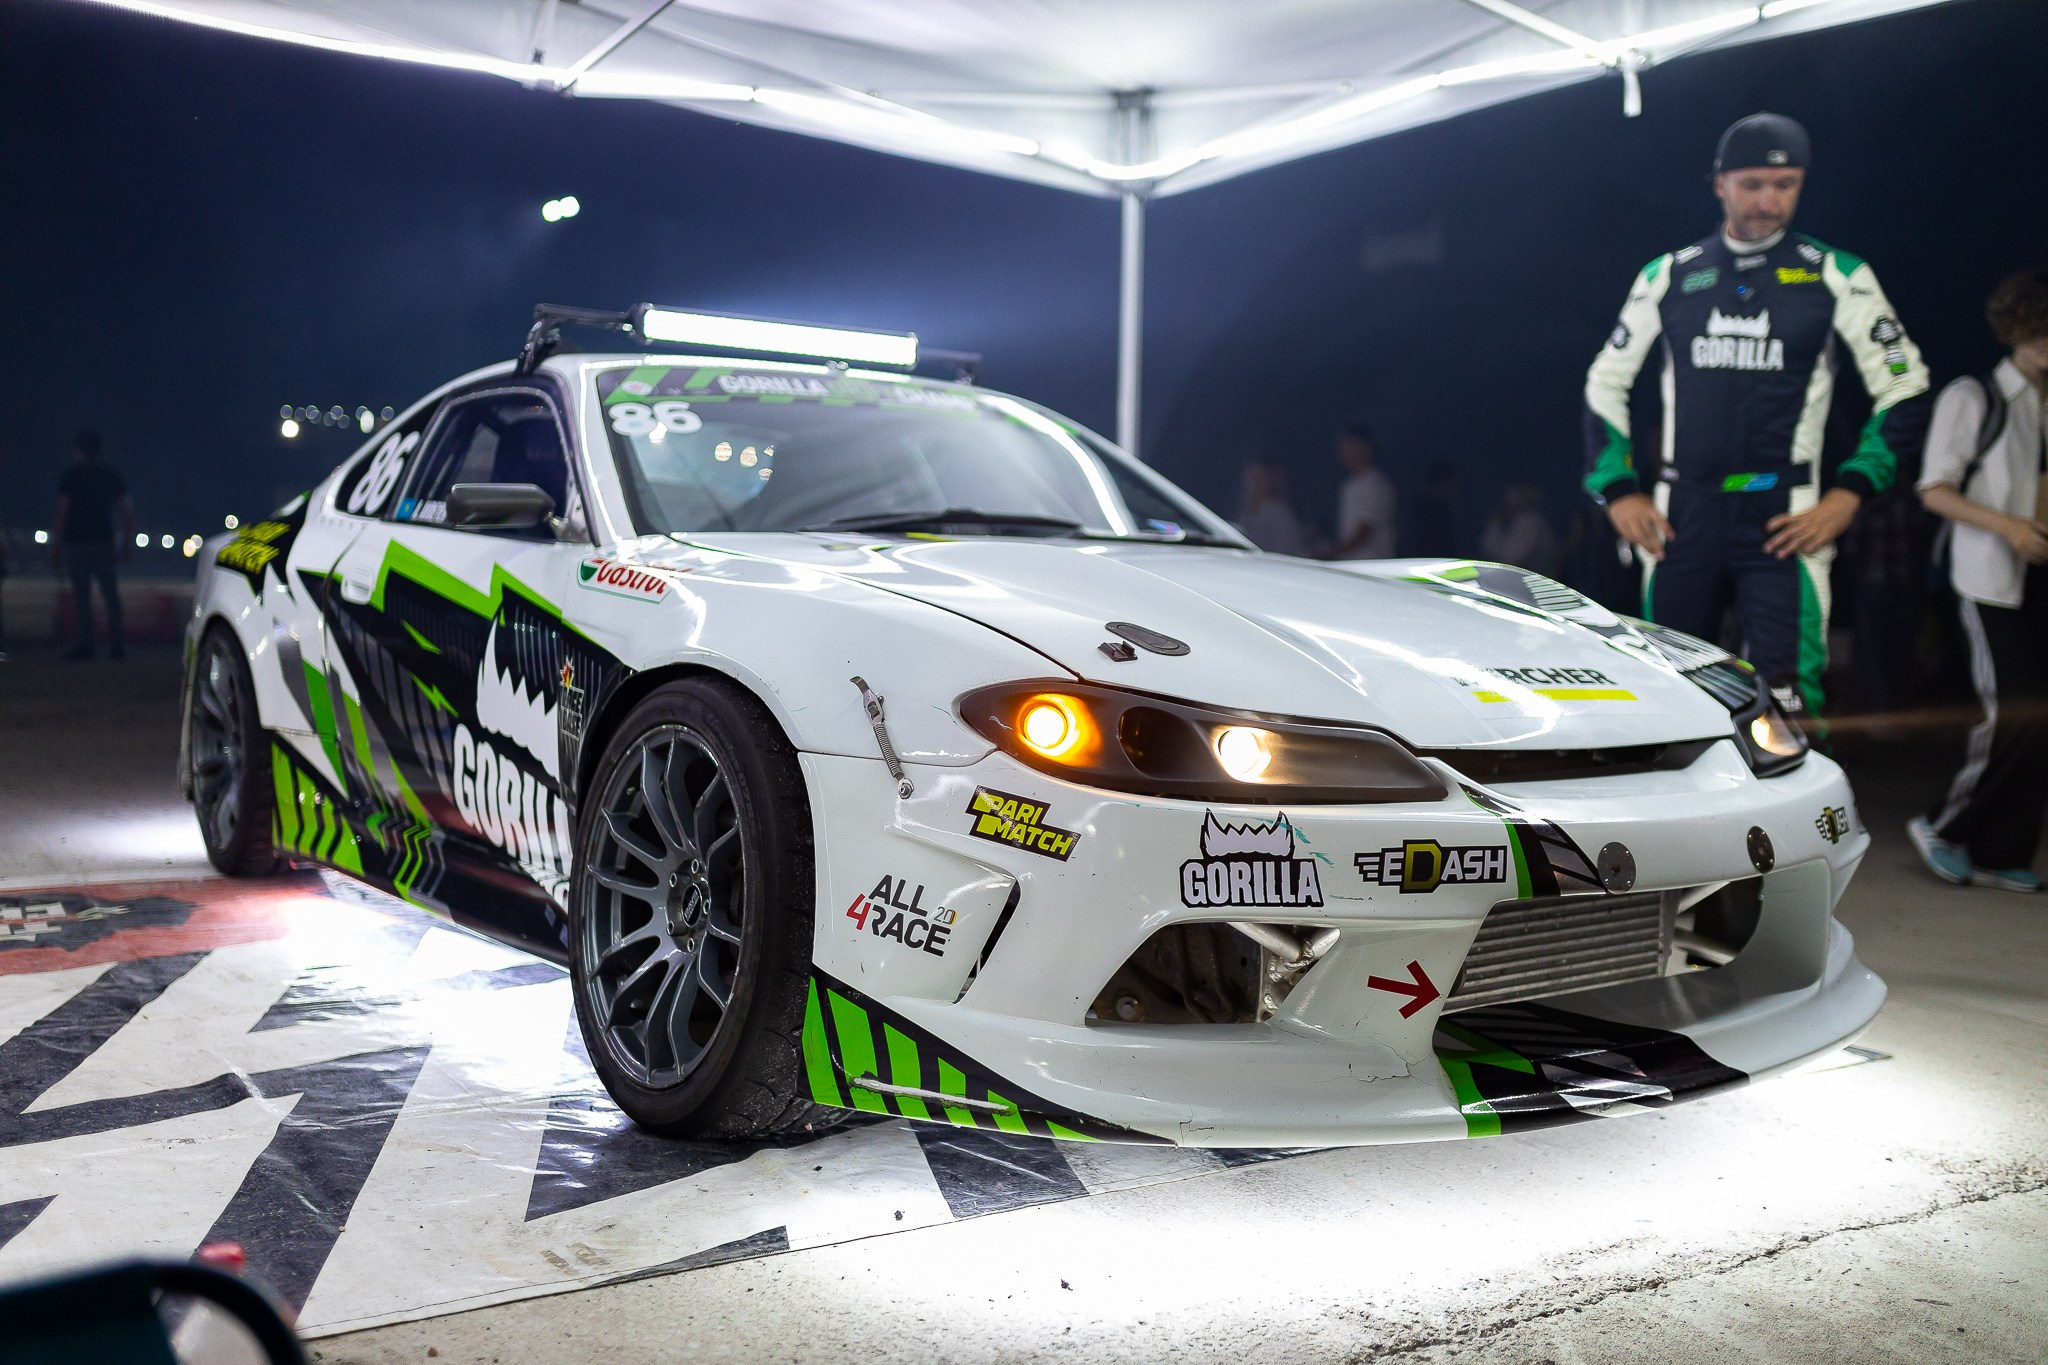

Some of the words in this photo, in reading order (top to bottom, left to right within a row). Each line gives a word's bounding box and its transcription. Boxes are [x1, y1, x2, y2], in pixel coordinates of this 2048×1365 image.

[1691, 336, 1784, 370] GORILLA
[718, 374, 828, 397] GORILLA
[609, 401, 703, 434] 86
[347, 431, 420, 515] 86
[1458, 666, 1619, 686] RCHER
[453, 723, 574, 890] GORILL
[975, 793, 1043, 825] PARI
[977, 813, 1073, 855] MATCH
[1184, 861, 1323, 905] GORILLA
[1383, 843, 1504, 890] EDASH
[868, 874, 928, 917] ALL
